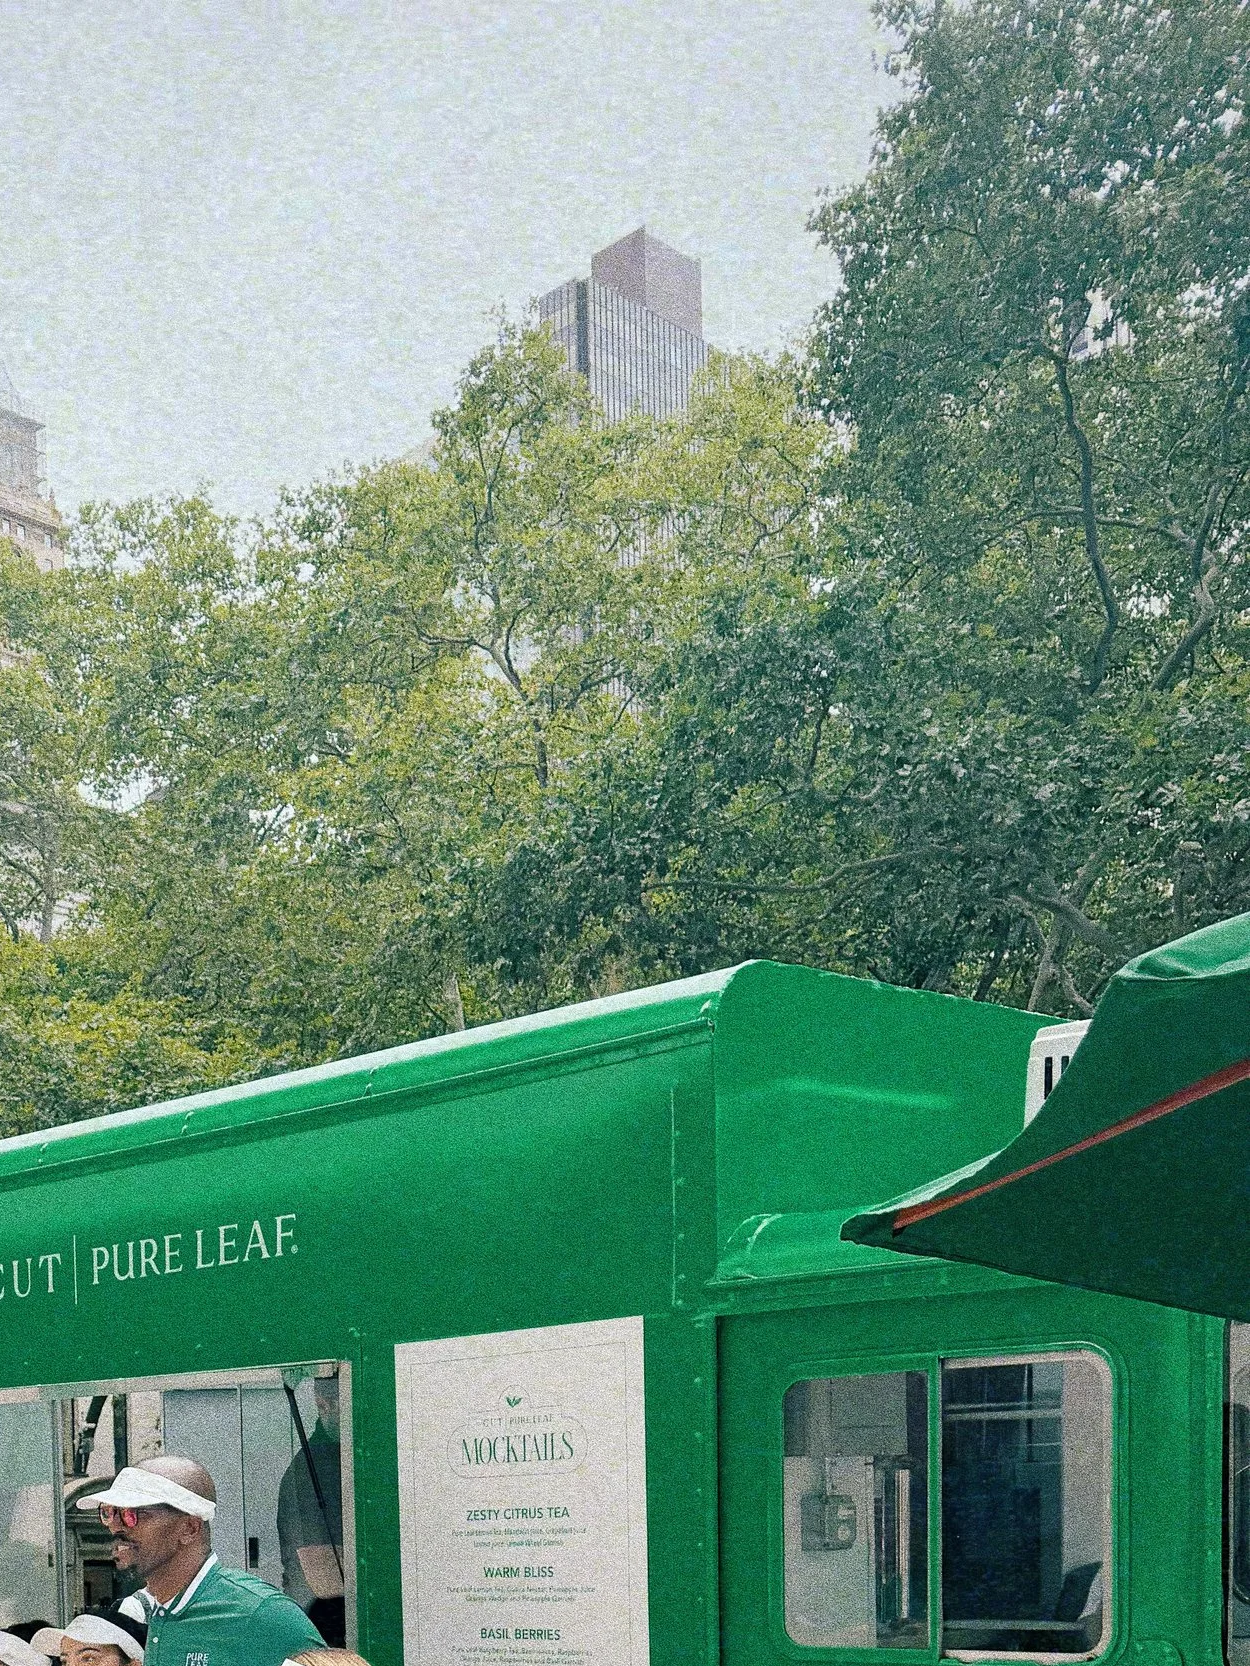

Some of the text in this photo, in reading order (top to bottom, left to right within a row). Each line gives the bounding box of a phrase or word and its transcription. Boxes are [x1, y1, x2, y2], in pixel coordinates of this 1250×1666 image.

[91, 1233, 183, 1285] PURE
[462, 1431, 574, 1465] MOCKTAILS
[467, 1507, 570, 1521] ZESTY CITRUS TEA
[484, 1566, 554, 1578] WARM BLISS
[480, 1628, 561, 1640] BASIL BERRIES
[187, 1652, 210, 1662] PURE
